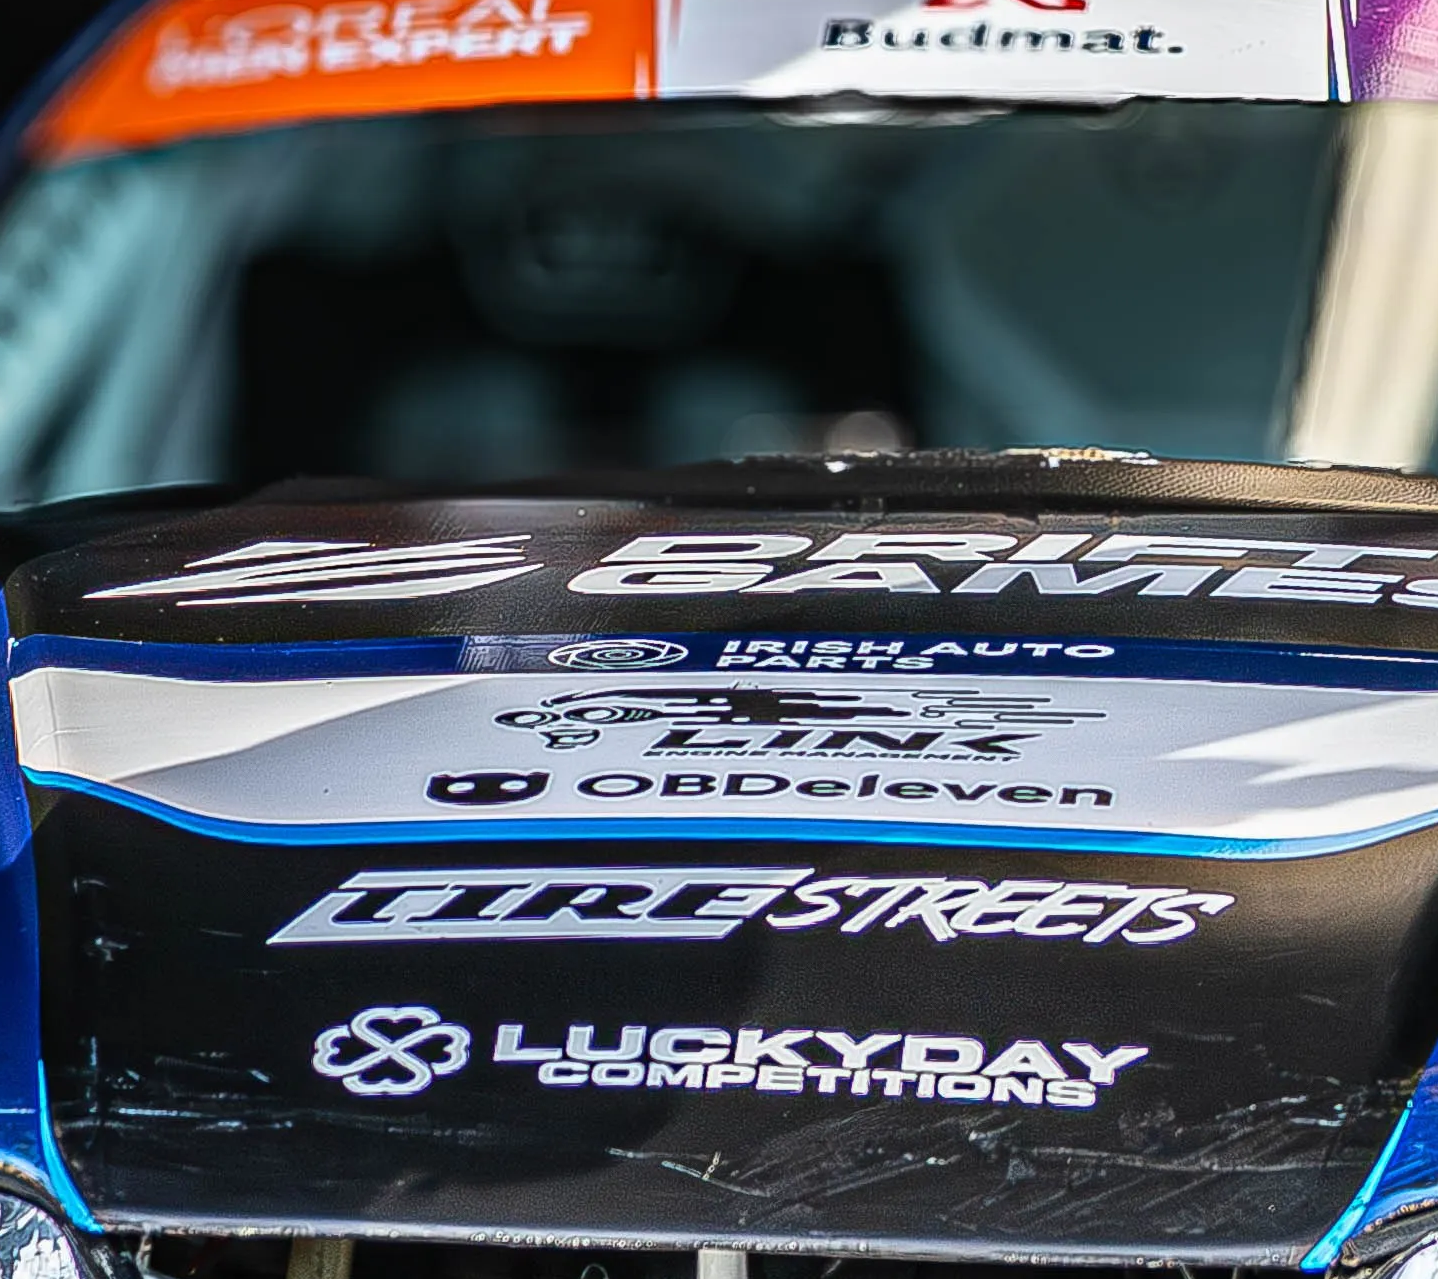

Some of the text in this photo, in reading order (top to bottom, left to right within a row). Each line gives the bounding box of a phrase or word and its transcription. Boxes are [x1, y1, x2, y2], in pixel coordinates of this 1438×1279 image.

[319, 14, 590, 72] EXPERT
[822, 17, 1184, 54] Budmat.
[715, 654, 935, 670] PARTS
[721, 639, 1117, 659] IRISH AUTO
[651, 728, 1044, 756] LINK
[577, 772, 1117, 809] OBDeleven
[766, 873, 1238, 945] STREETS
[493, 1023, 1148, 1084] LUCKYDAY
[537, 1061, 1097, 1108] COMPETITIONS
